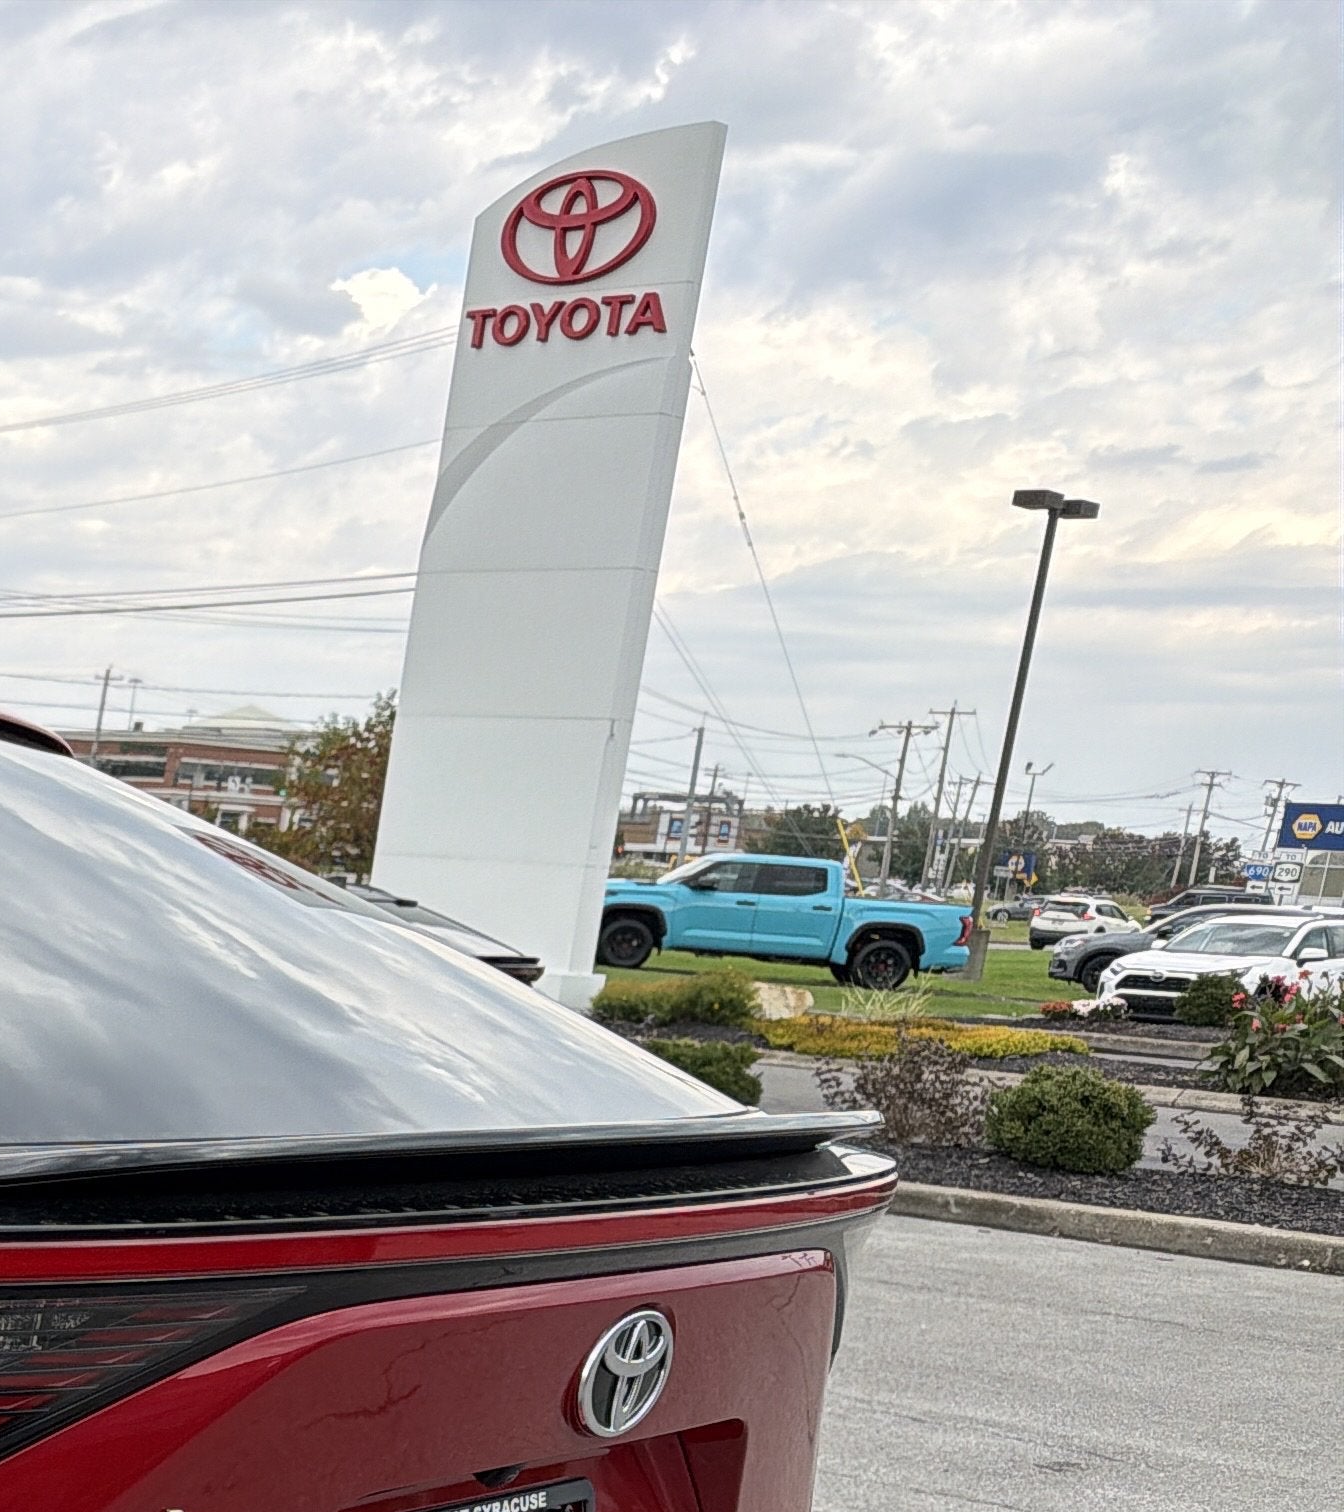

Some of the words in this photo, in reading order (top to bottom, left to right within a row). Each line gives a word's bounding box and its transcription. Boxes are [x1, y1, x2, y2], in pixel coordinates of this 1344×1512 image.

[466, 291, 667, 349] TOYOTA
[1297, 821, 1318, 832] NAPA
[1248, 866, 1270, 876] 690
[1277, 867, 1298, 877] 290
